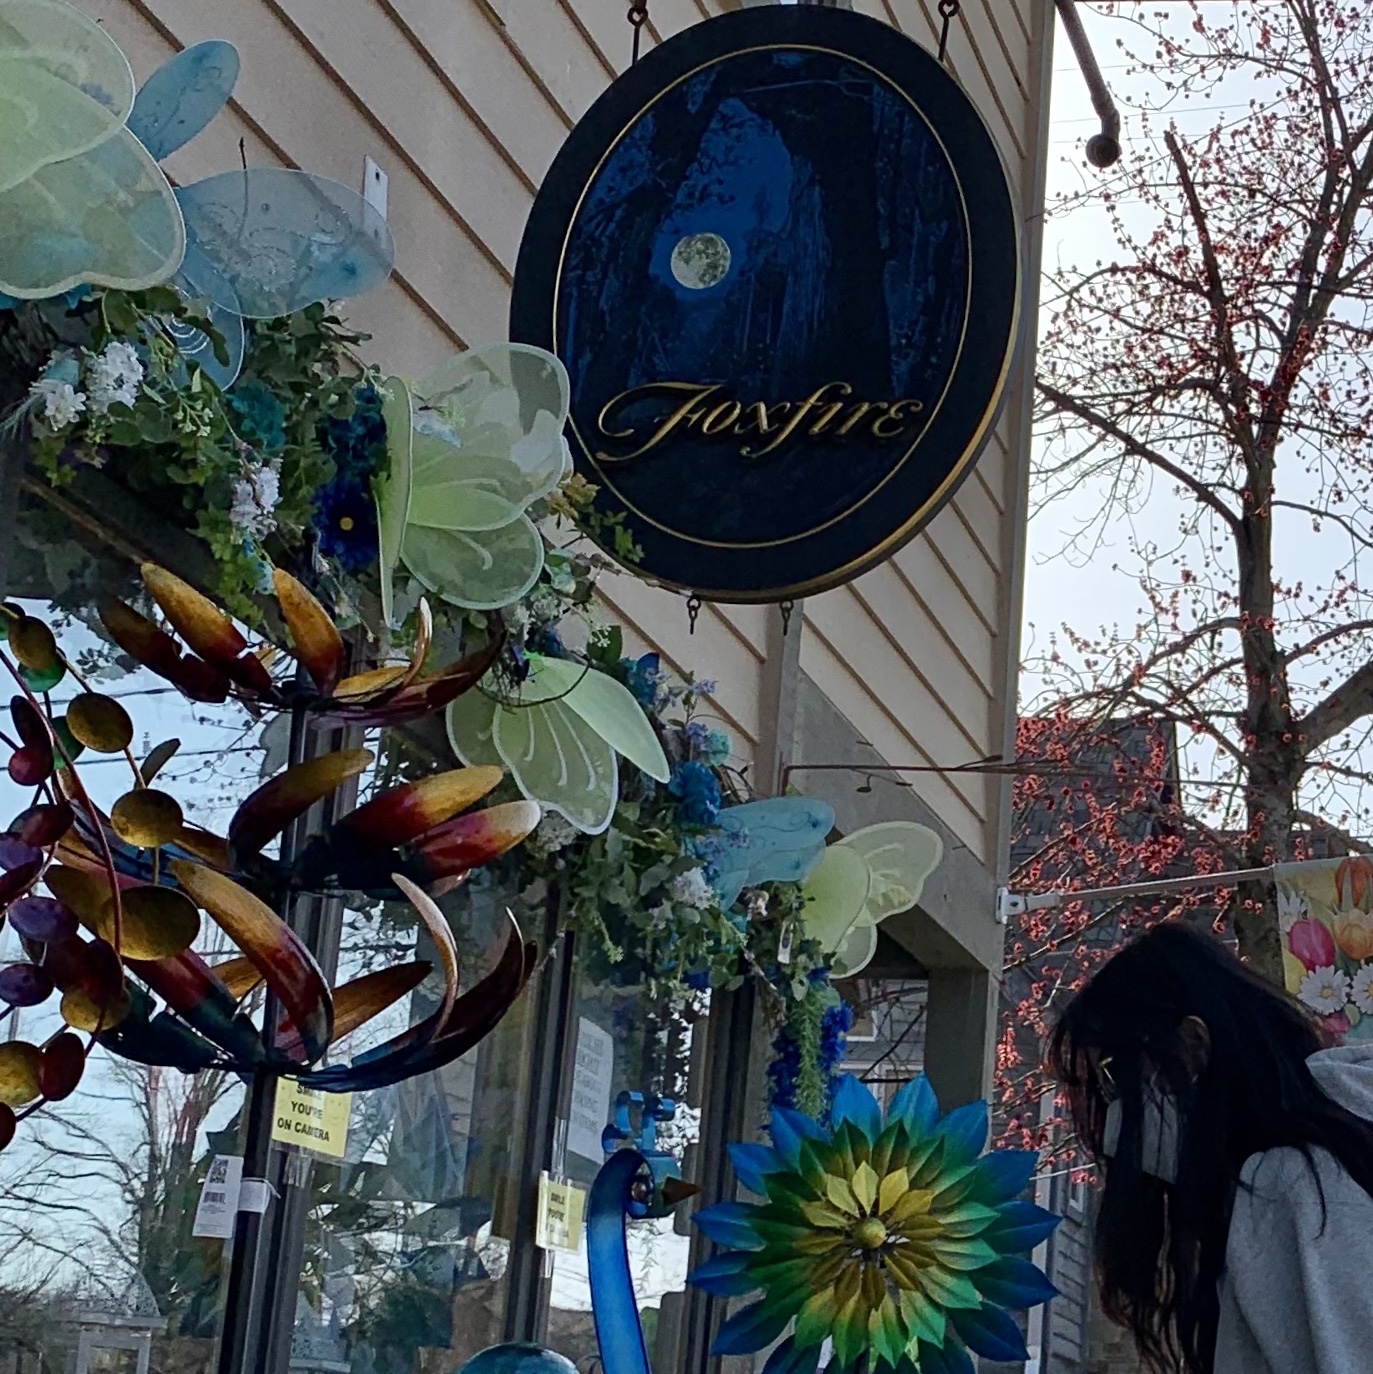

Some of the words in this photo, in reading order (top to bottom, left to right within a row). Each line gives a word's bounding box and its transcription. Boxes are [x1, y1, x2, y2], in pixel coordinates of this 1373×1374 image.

[596, 381, 923, 461] Foxfire
[277, 1117, 292, 1131] ON
[294, 1122, 330, 1142] CAMERA
